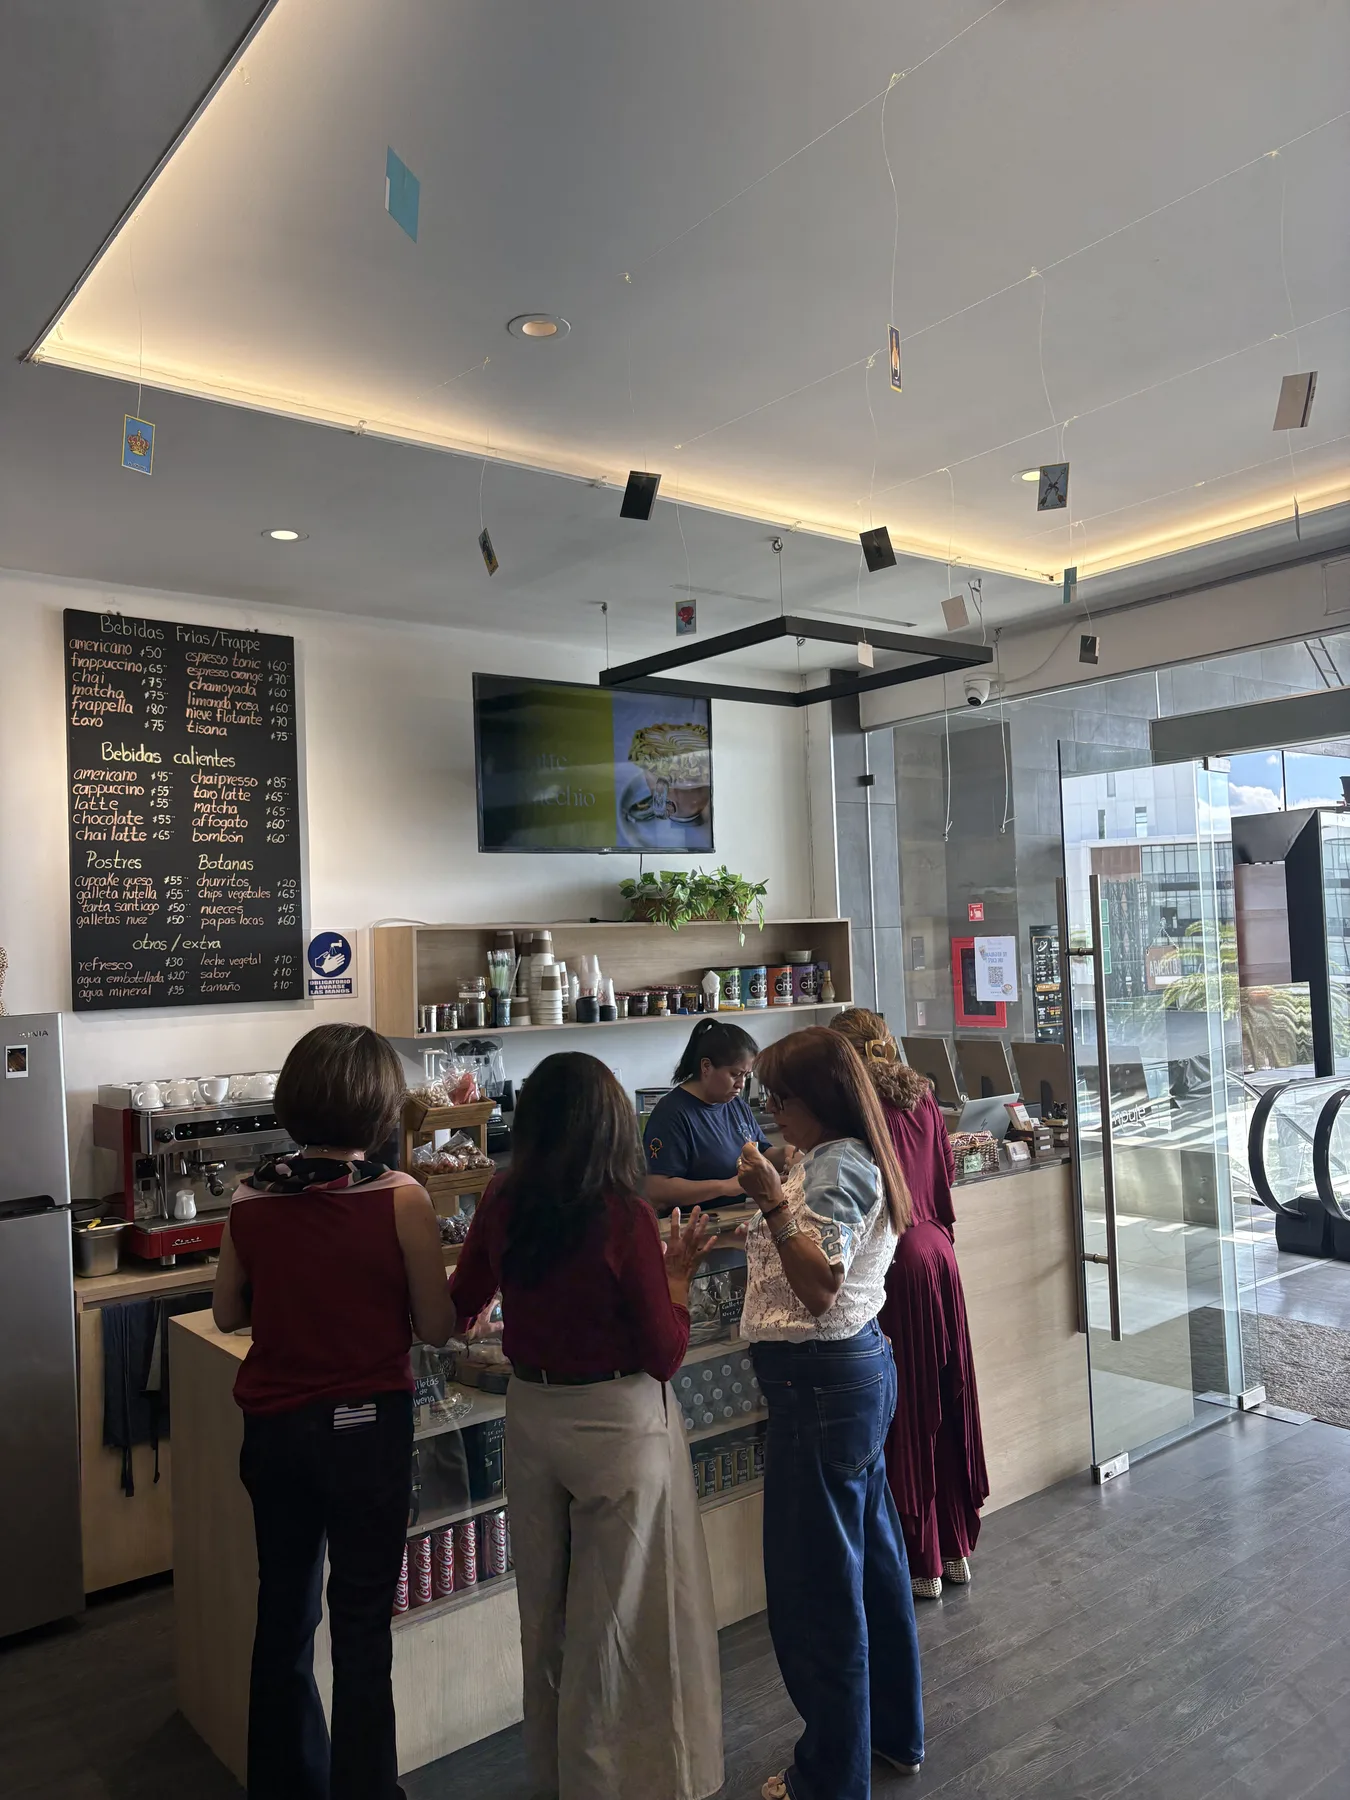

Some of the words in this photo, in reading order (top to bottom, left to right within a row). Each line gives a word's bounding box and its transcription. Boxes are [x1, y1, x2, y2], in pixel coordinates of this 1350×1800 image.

[100, 614, 165, 640] Bebidas
[69, 639, 133, 655] americano
[71, 652, 143, 673] frappuccino
[185, 652, 228, 666] espresso
[232, 651, 262, 669] tonic
[72, 669, 105, 684] chai
[186, 666, 230, 679] espresso
[72, 683, 125, 699] matcha
[189, 677, 257, 699] chamoyada
[71, 696, 134, 715] frappella
[235, 701, 260, 712] rosa
[71, 710, 104, 727] taro
[185, 707, 213, 721] nieve
[186, 720, 228, 736] tisana
[101, 741, 162, 764] Bebidas
[173, 745, 236, 767] calientes
[73, 767, 138, 782] americano
[190, 768, 259, 789] chaipresso
[72, 783, 145, 798] cappuccino
[193, 785, 218, 800] taro
[221, 786, 251, 802] latte
[74, 795, 119, 811] latte
[193, 799, 238, 814] matcha
[72, 809, 145, 825] chocolate
[191, 814, 249, 832] affogato
[75, 825, 107, 841] chai
[110, 825, 148, 842] latte
[86, 850, 142, 869] Postres
[198, 853, 254, 871] Botanas
[122, 876, 154, 890] queso
[196, 872, 250, 888] churritos
[76, 886, 119, 904] galleta
[122, 886, 157, 900] nutella
[197, 886, 223, 902] chips
[227, 886, 271, 904] vegetales
[82, 900, 111, 914] tarta
[114, 899, 160, 915] santiago
[200, 905, 244, 915] nueces
[76, 914, 121, 929] galletas
[125, 915, 149, 925] nuez
[239, 913, 265, 926] locas
[78, 956, 134, 972] refresco
[200, 952, 226, 966] leche
[228, 952, 262, 969] vegetal
[1149, 959, 1179, 976] ABIERTO
[77, 976, 102, 989] agua
[106, 969, 165, 985] embotellada
[200, 967, 231, 979] sabor
[78, 989, 104, 1003] agua
[108, 984, 152, 998] mineral
[414, 1377, 440, 1390] lletas
